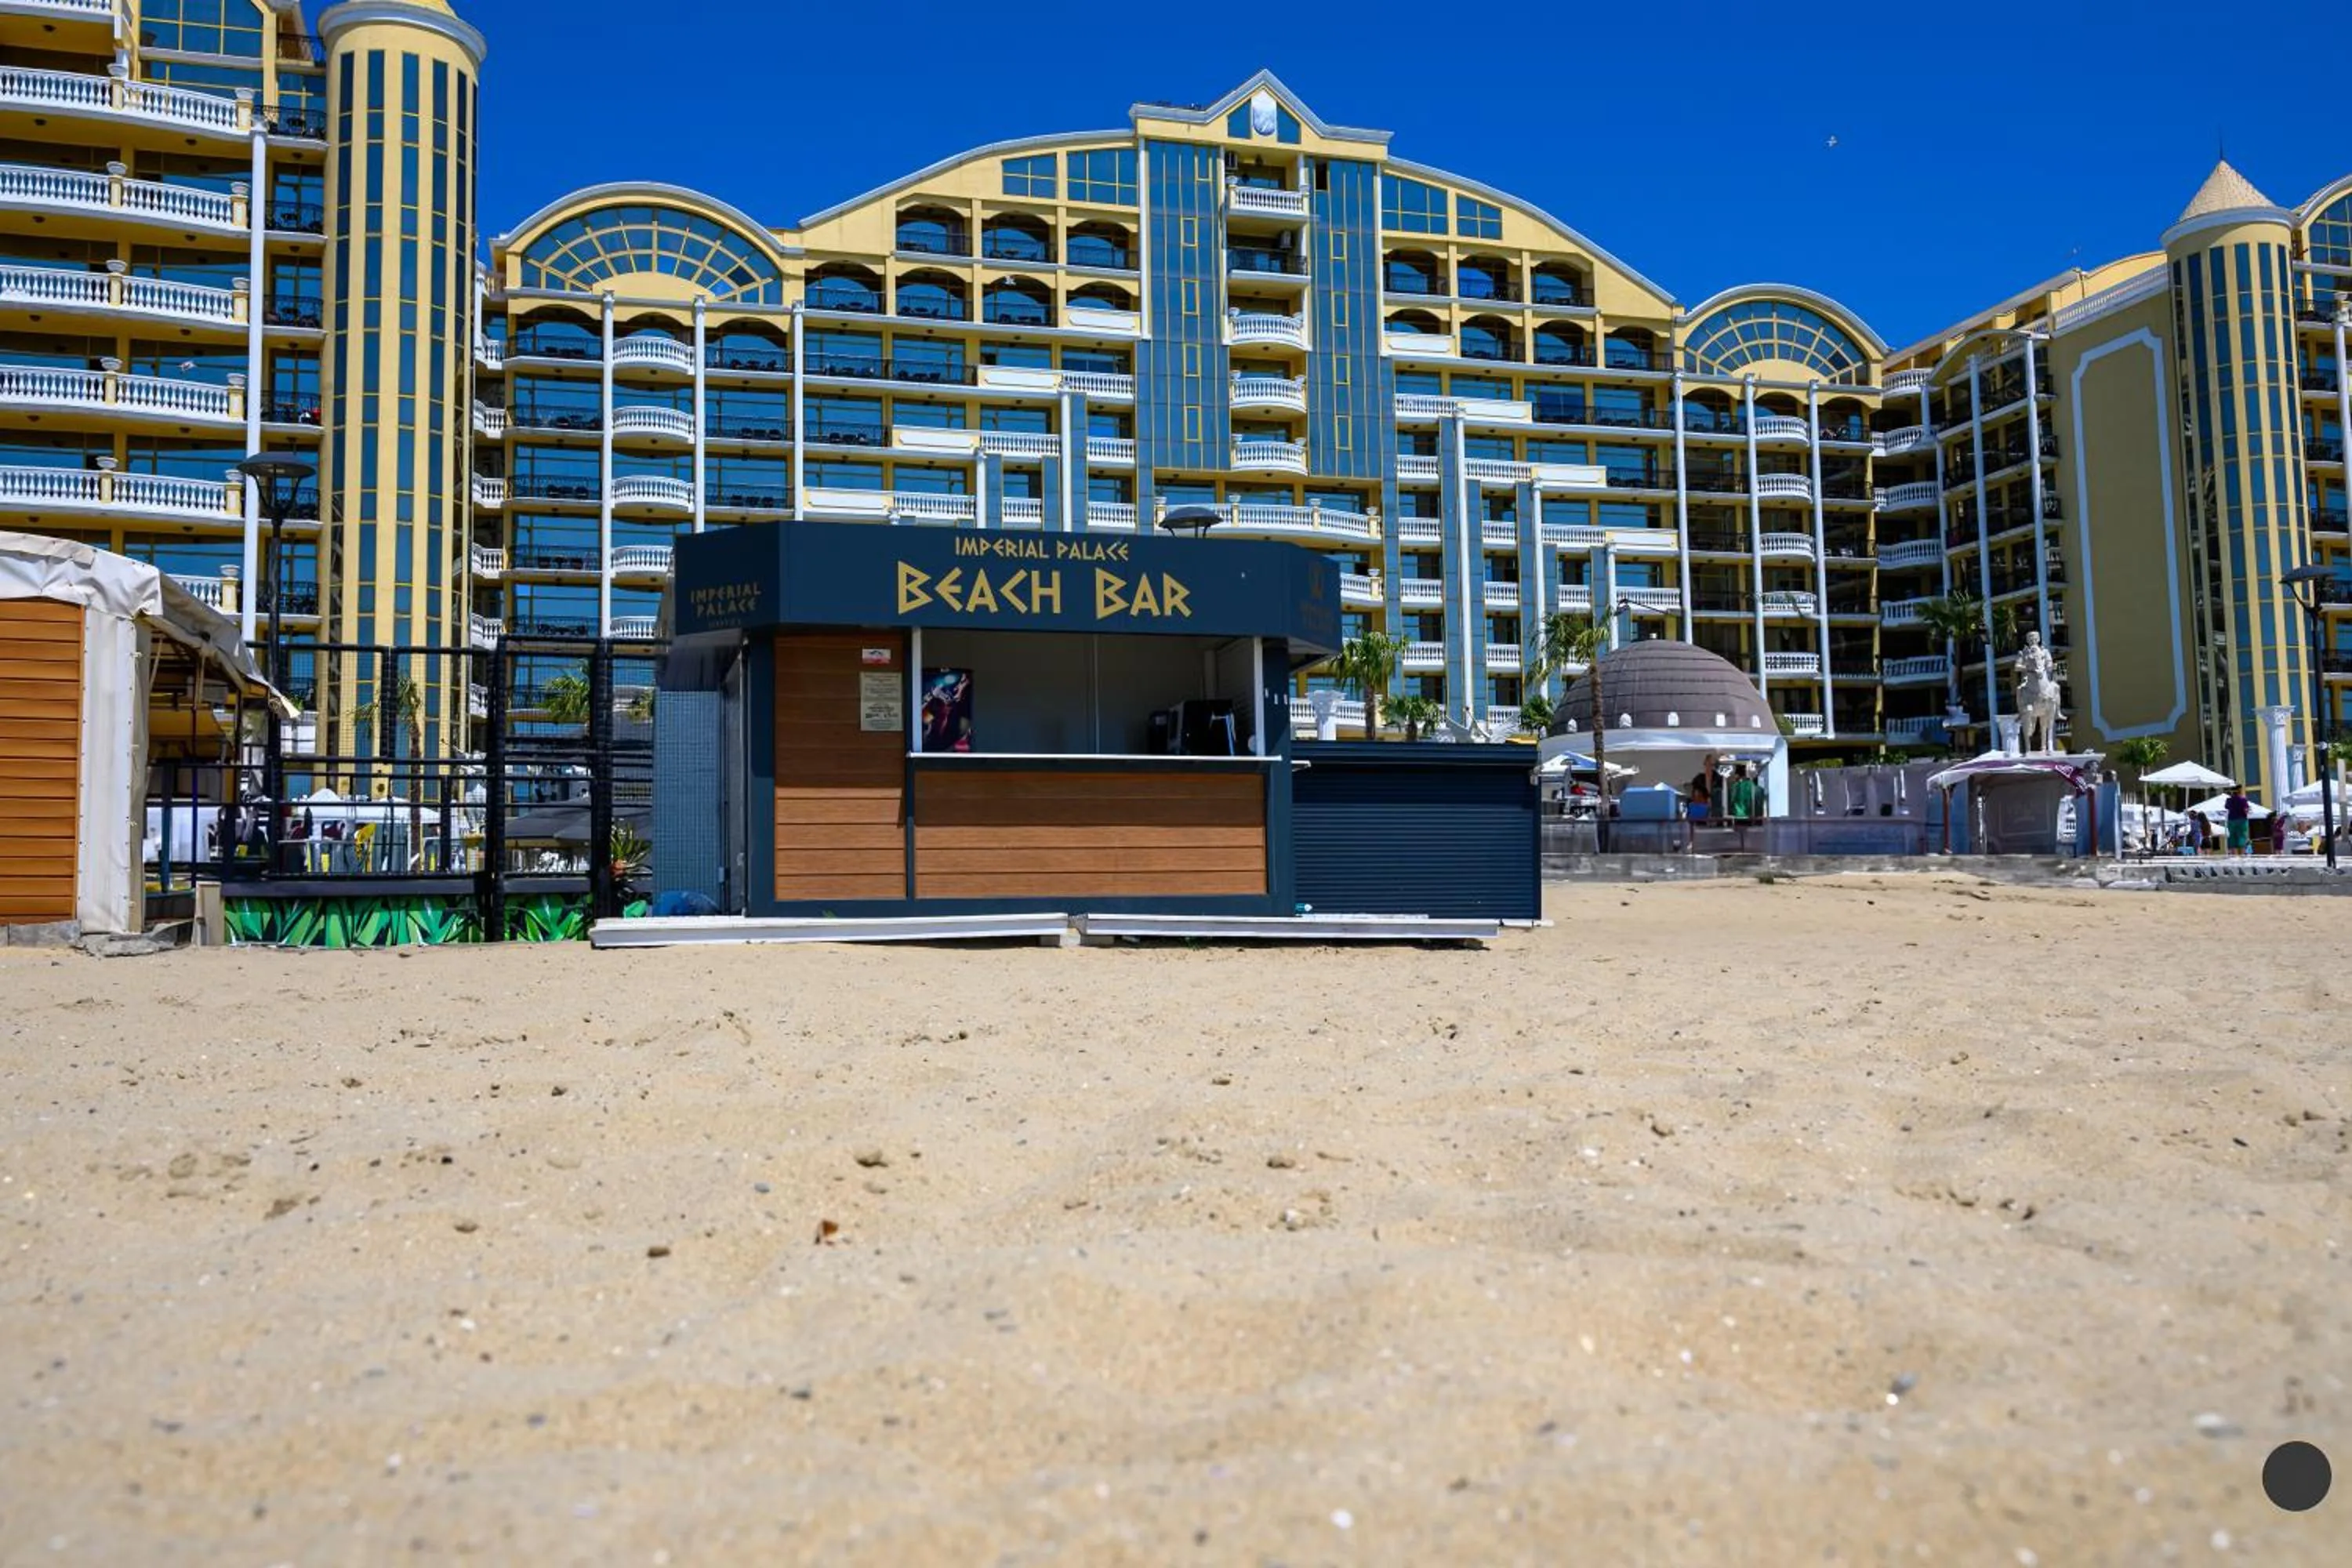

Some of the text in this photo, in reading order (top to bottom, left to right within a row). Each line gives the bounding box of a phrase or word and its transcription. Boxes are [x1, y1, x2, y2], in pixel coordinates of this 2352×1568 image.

[954, 536, 1130, 561] IMPERIAL PALACE
[690, 582, 762, 604] IMPERIAL
[896, 561, 1192, 620] BEACH BAR
[696, 597, 757, 618] PALACE
